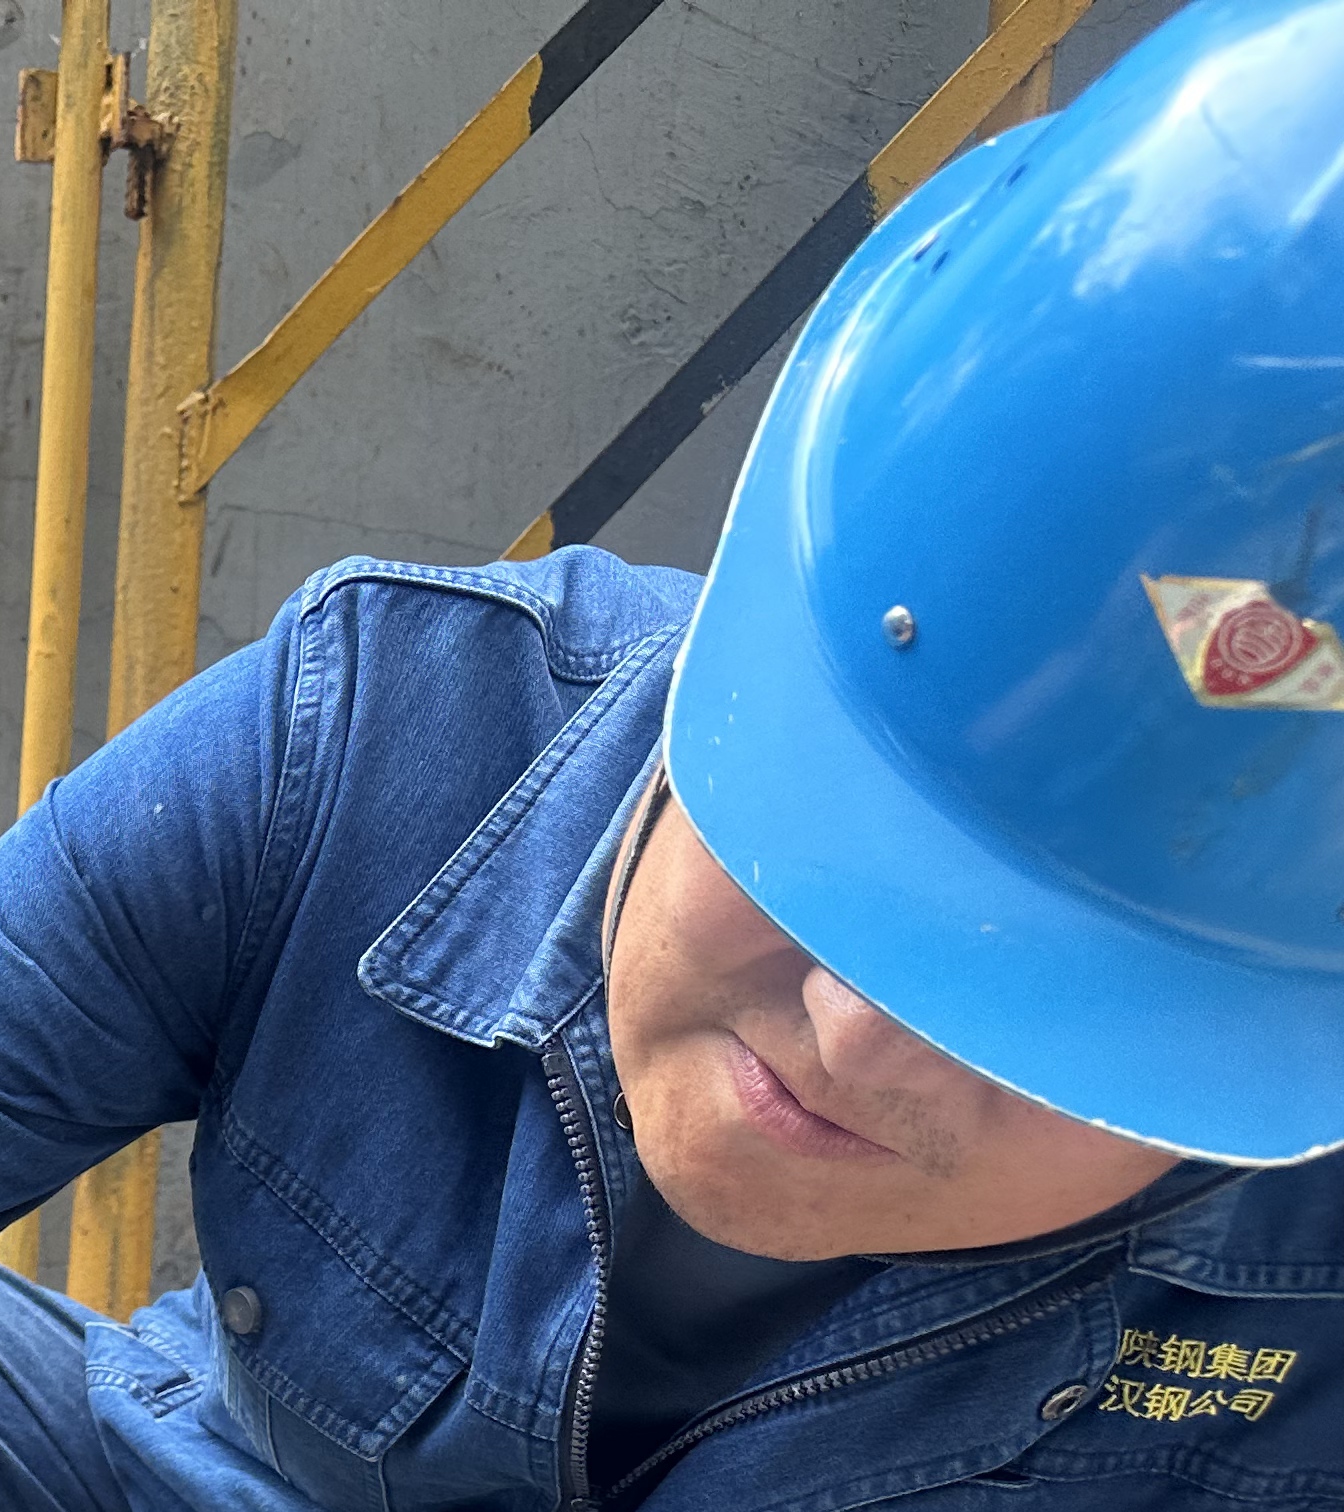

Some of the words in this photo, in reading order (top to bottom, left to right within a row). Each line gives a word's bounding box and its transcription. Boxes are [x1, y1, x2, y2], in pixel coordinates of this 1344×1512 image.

[1117, 1328, 1299, 1384] 陕钢集团
[1098, 1374, 1276, 1422] 汉钢公司
